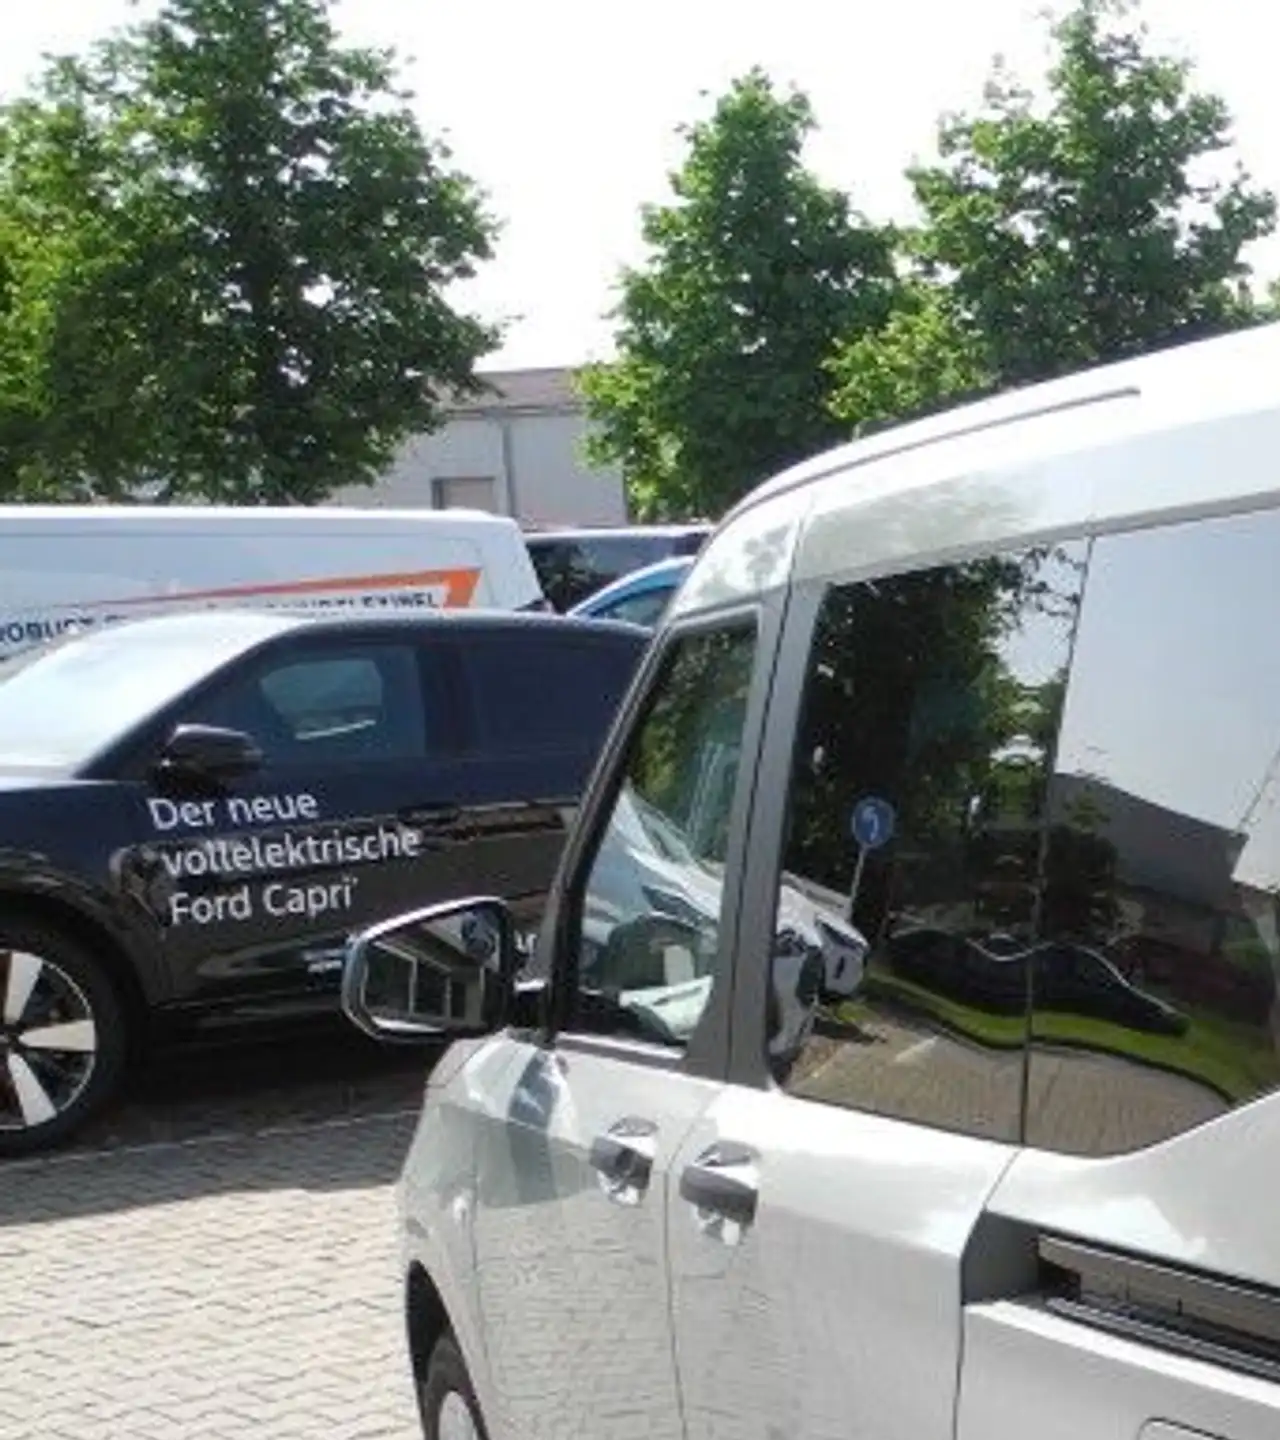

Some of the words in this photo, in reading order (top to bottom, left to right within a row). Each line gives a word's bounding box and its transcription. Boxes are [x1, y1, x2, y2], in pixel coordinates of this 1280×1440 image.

[148, 798, 216, 831] Der
[227, 793, 319, 824] neue
[161, 825, 424, 877] vollelektrische
[170, 886, 251, 925] Ford
